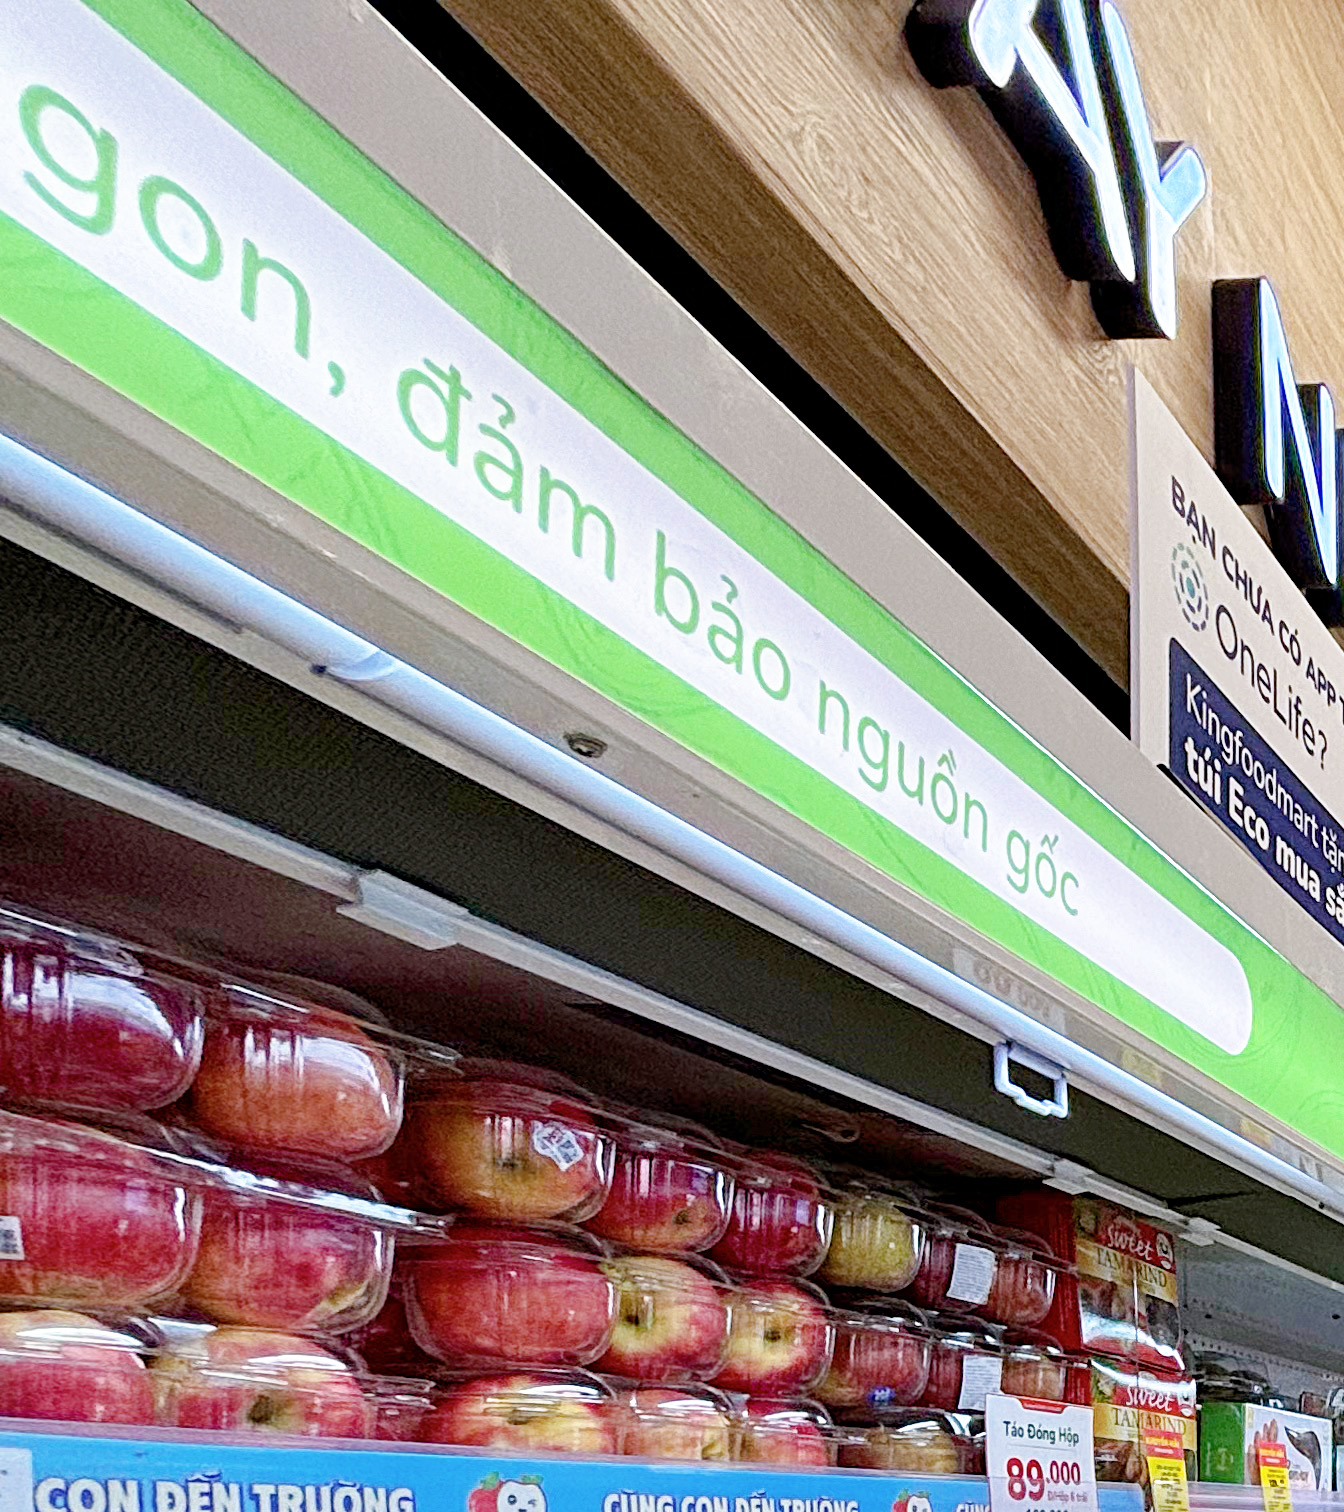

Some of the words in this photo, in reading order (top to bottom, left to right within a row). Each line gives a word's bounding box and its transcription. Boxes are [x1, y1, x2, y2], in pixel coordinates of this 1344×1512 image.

[397, 357, 617, 582] đảm
[654, 531, 792, 701] bảo
[818, 679, 988, 853] nguồn
[1006, 833, 1079, 916] gốc
[1171, 475, 1217, 560] BẠN
[1222, 545, 1275, 636] CHƯA
[1279, 620, 1302, 667] CÓ
[1305, 657, 1336, 706] APP
[1185, 672, 1319, 845] Kingfoodmart
[1216, 604, 1328, 770] OneLife?
[1184, 737, 1222, 804] túi
[1229, 774, 1270, 848] Eco
[1275, 836, 1322, 906] mua
[1003, 1420, 1025, 1438] Táo
[1027, 1423, 1056, 1445] Đóng
[1059, 1426, 1080, 1448] Hộp
[1007, 1457, 1081, 1502] 89.000
[1111, 1407, 1188, 1436] TAMARIND
[1126, 1384, 1177, 1412] Sweet
